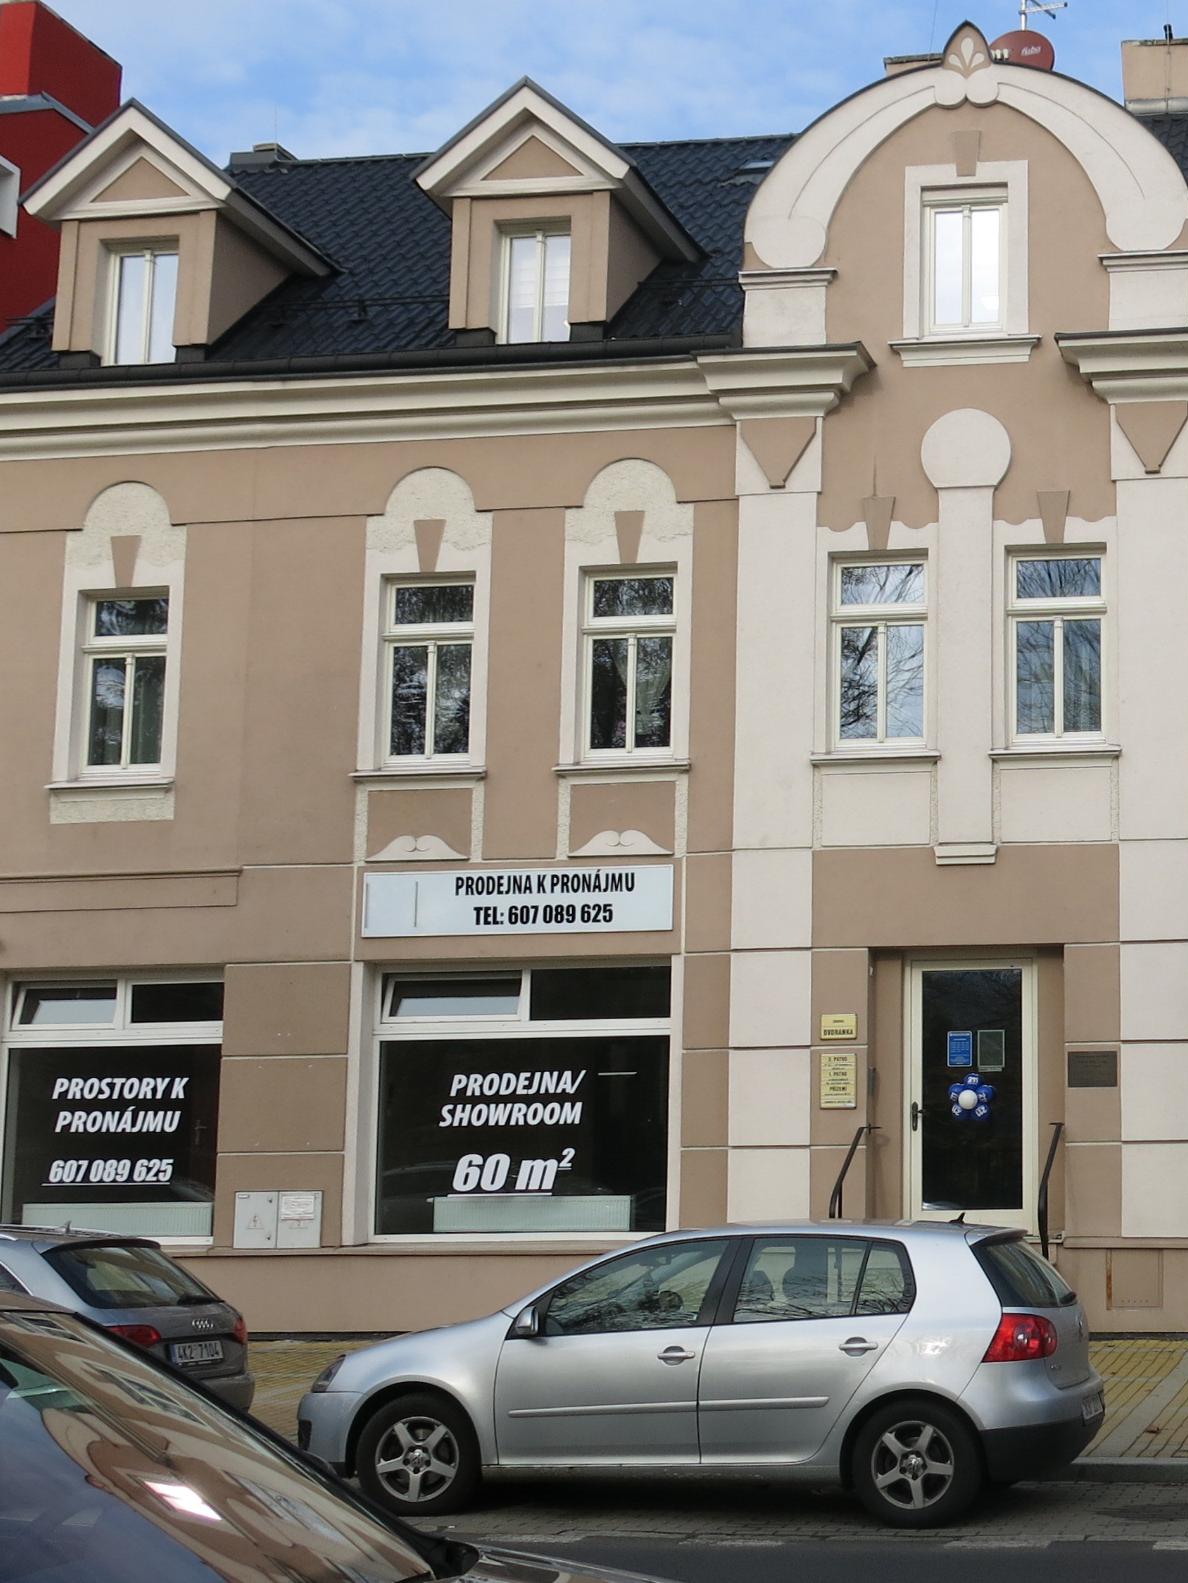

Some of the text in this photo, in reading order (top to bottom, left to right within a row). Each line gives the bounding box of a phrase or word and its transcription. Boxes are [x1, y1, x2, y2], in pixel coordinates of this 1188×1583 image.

[455, 869, 635, 896] PRODEJNA K PRONÁJMU
[474, 903, 613, 926] TEL: 607 089 625
[52, 1077, 190, 1100] PROSTORY K
[450, 1069, 587, 1097] PRODEJNA/
[54, 1106, 181, 1133] PRONÁJMU
[438, 1101, 583, 1127] SHOWROOM
[48, 1158, 174, 1183] 607 089 625
[452, 1153, 511, 1192] 60
